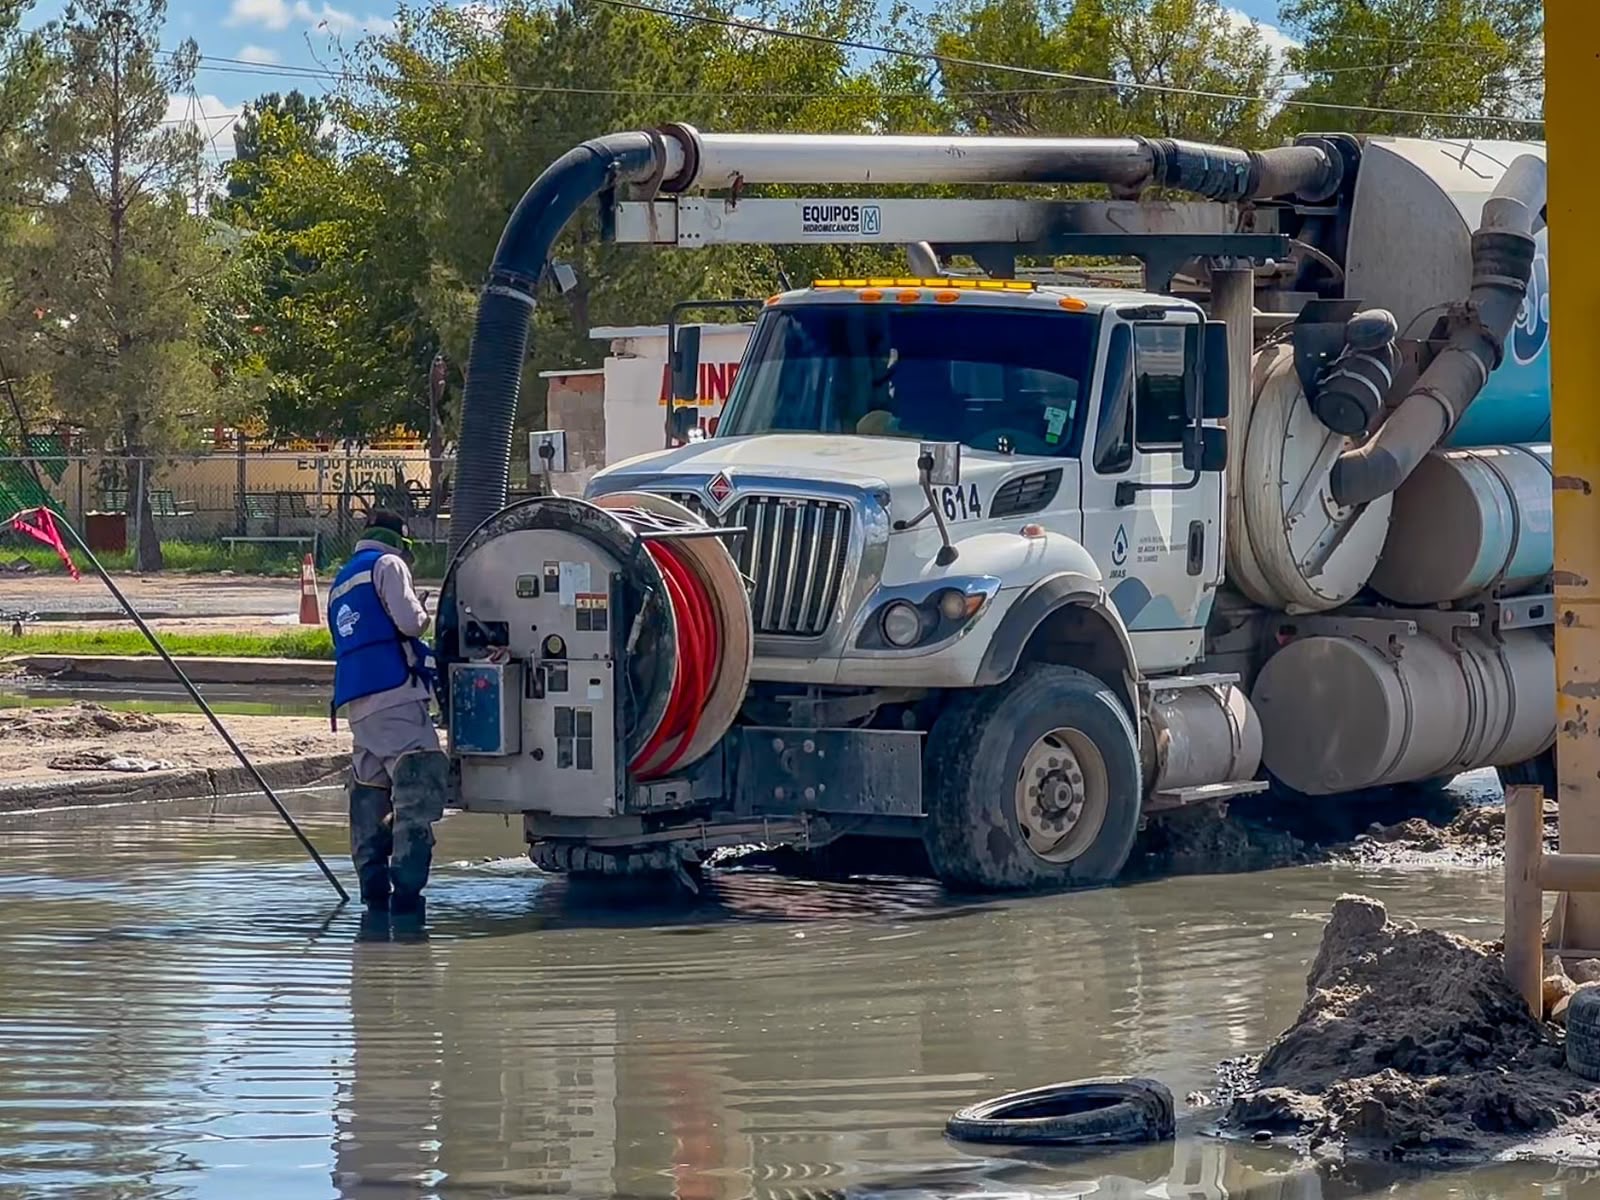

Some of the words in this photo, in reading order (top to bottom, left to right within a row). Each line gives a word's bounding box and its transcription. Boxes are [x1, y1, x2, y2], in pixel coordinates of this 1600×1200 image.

[802, 205, 860, 223] EQUIPOS
[802, 223, 860, 232] HIDROMECANICOS
[297, 455, 341, 470] EJDO
